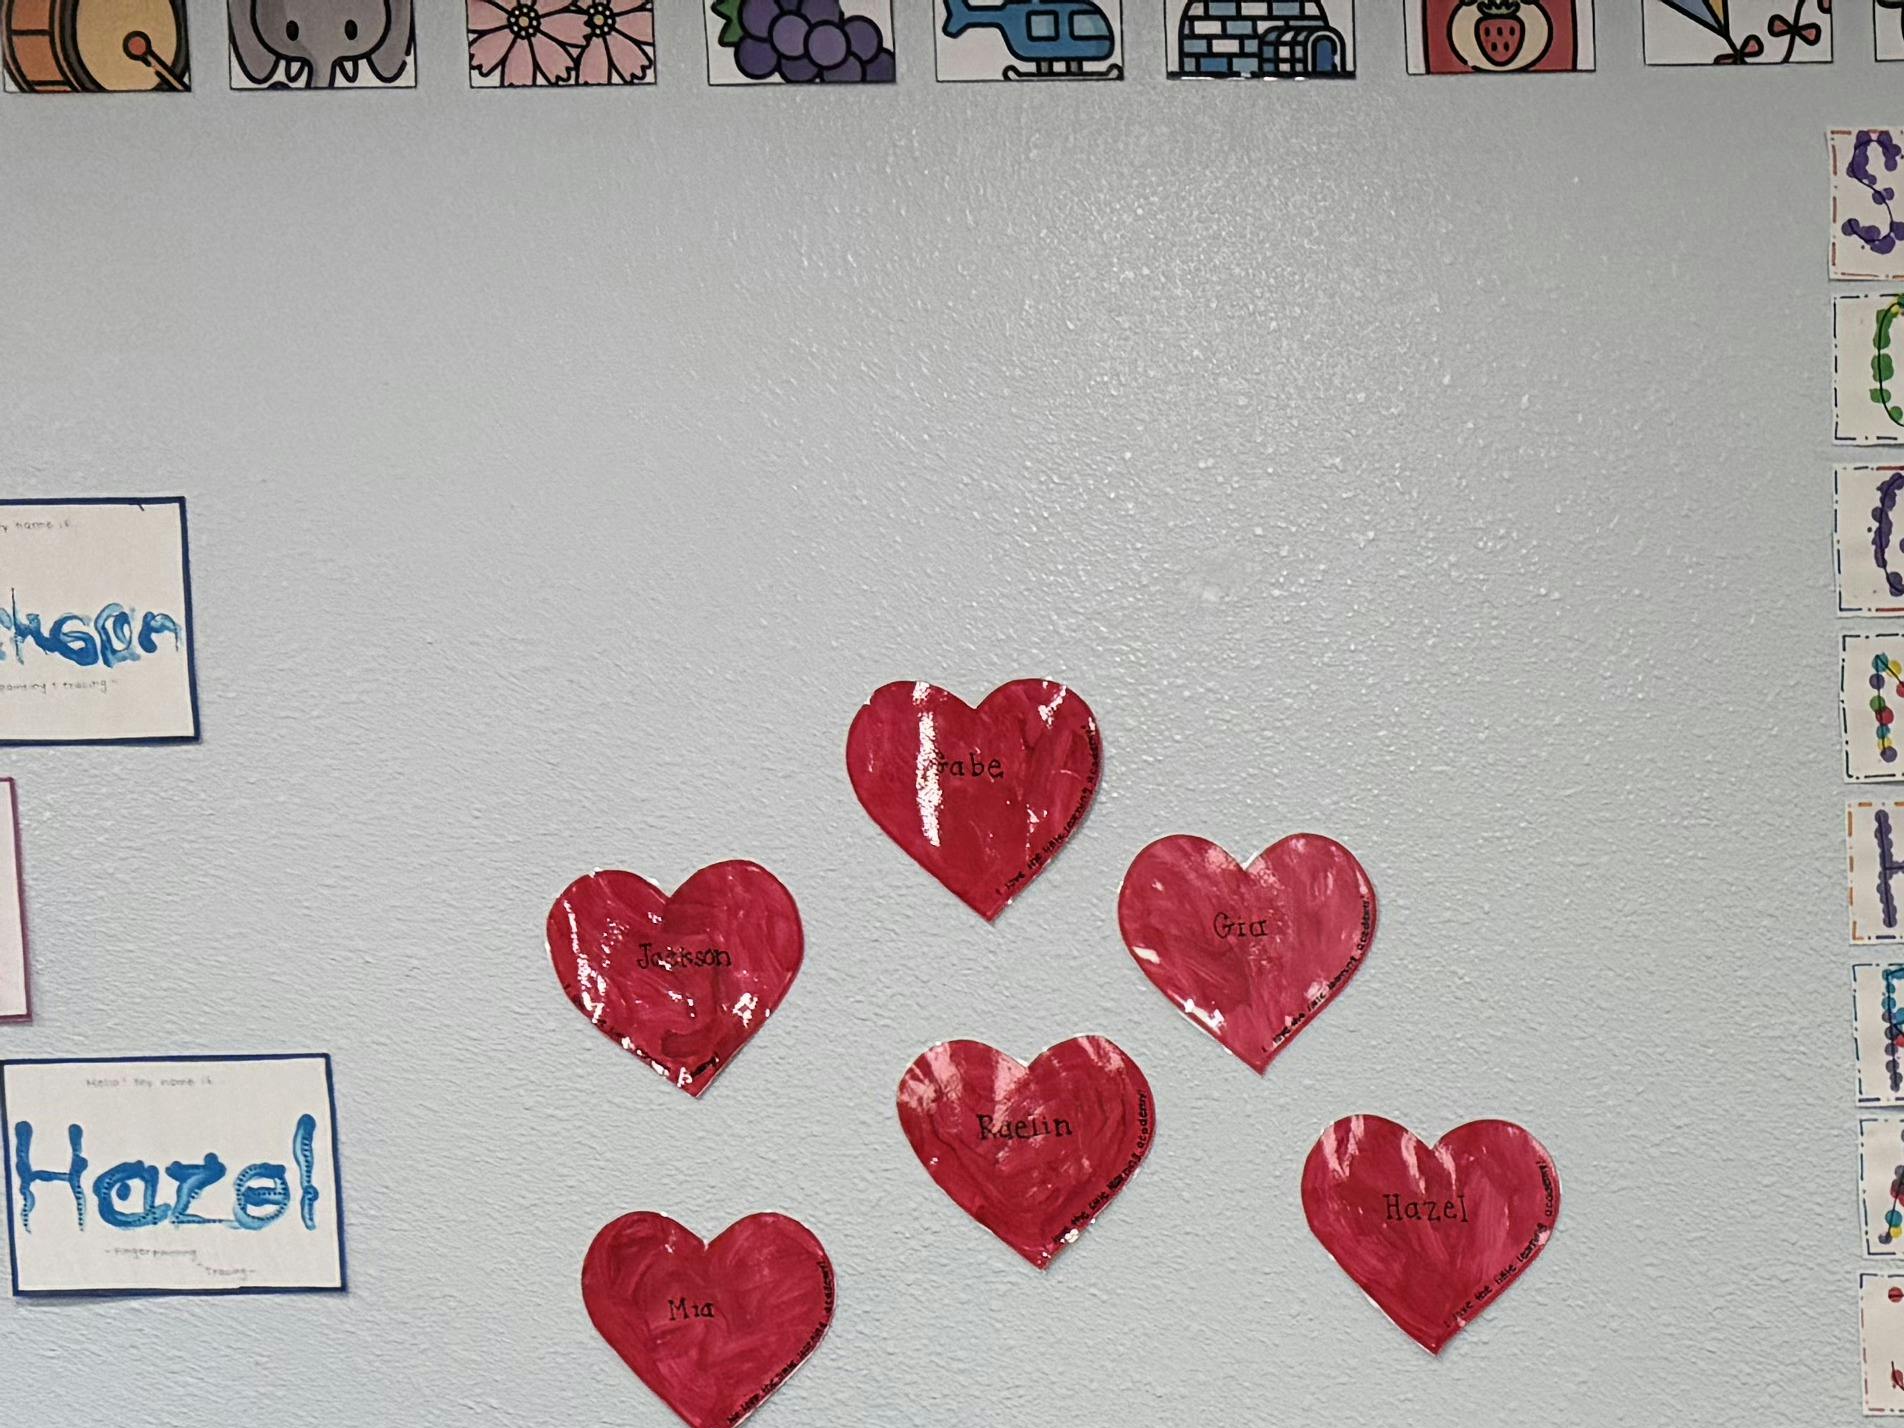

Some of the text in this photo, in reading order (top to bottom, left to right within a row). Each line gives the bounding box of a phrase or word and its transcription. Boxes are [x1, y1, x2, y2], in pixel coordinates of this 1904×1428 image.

[977, 1114, 1072, 1140] Raelin
[15, 1114, 319, 1234] Hazel
[1383, 1193, 1468, 1222] Hazel
[668, 1298, 714, 1320] Mia
